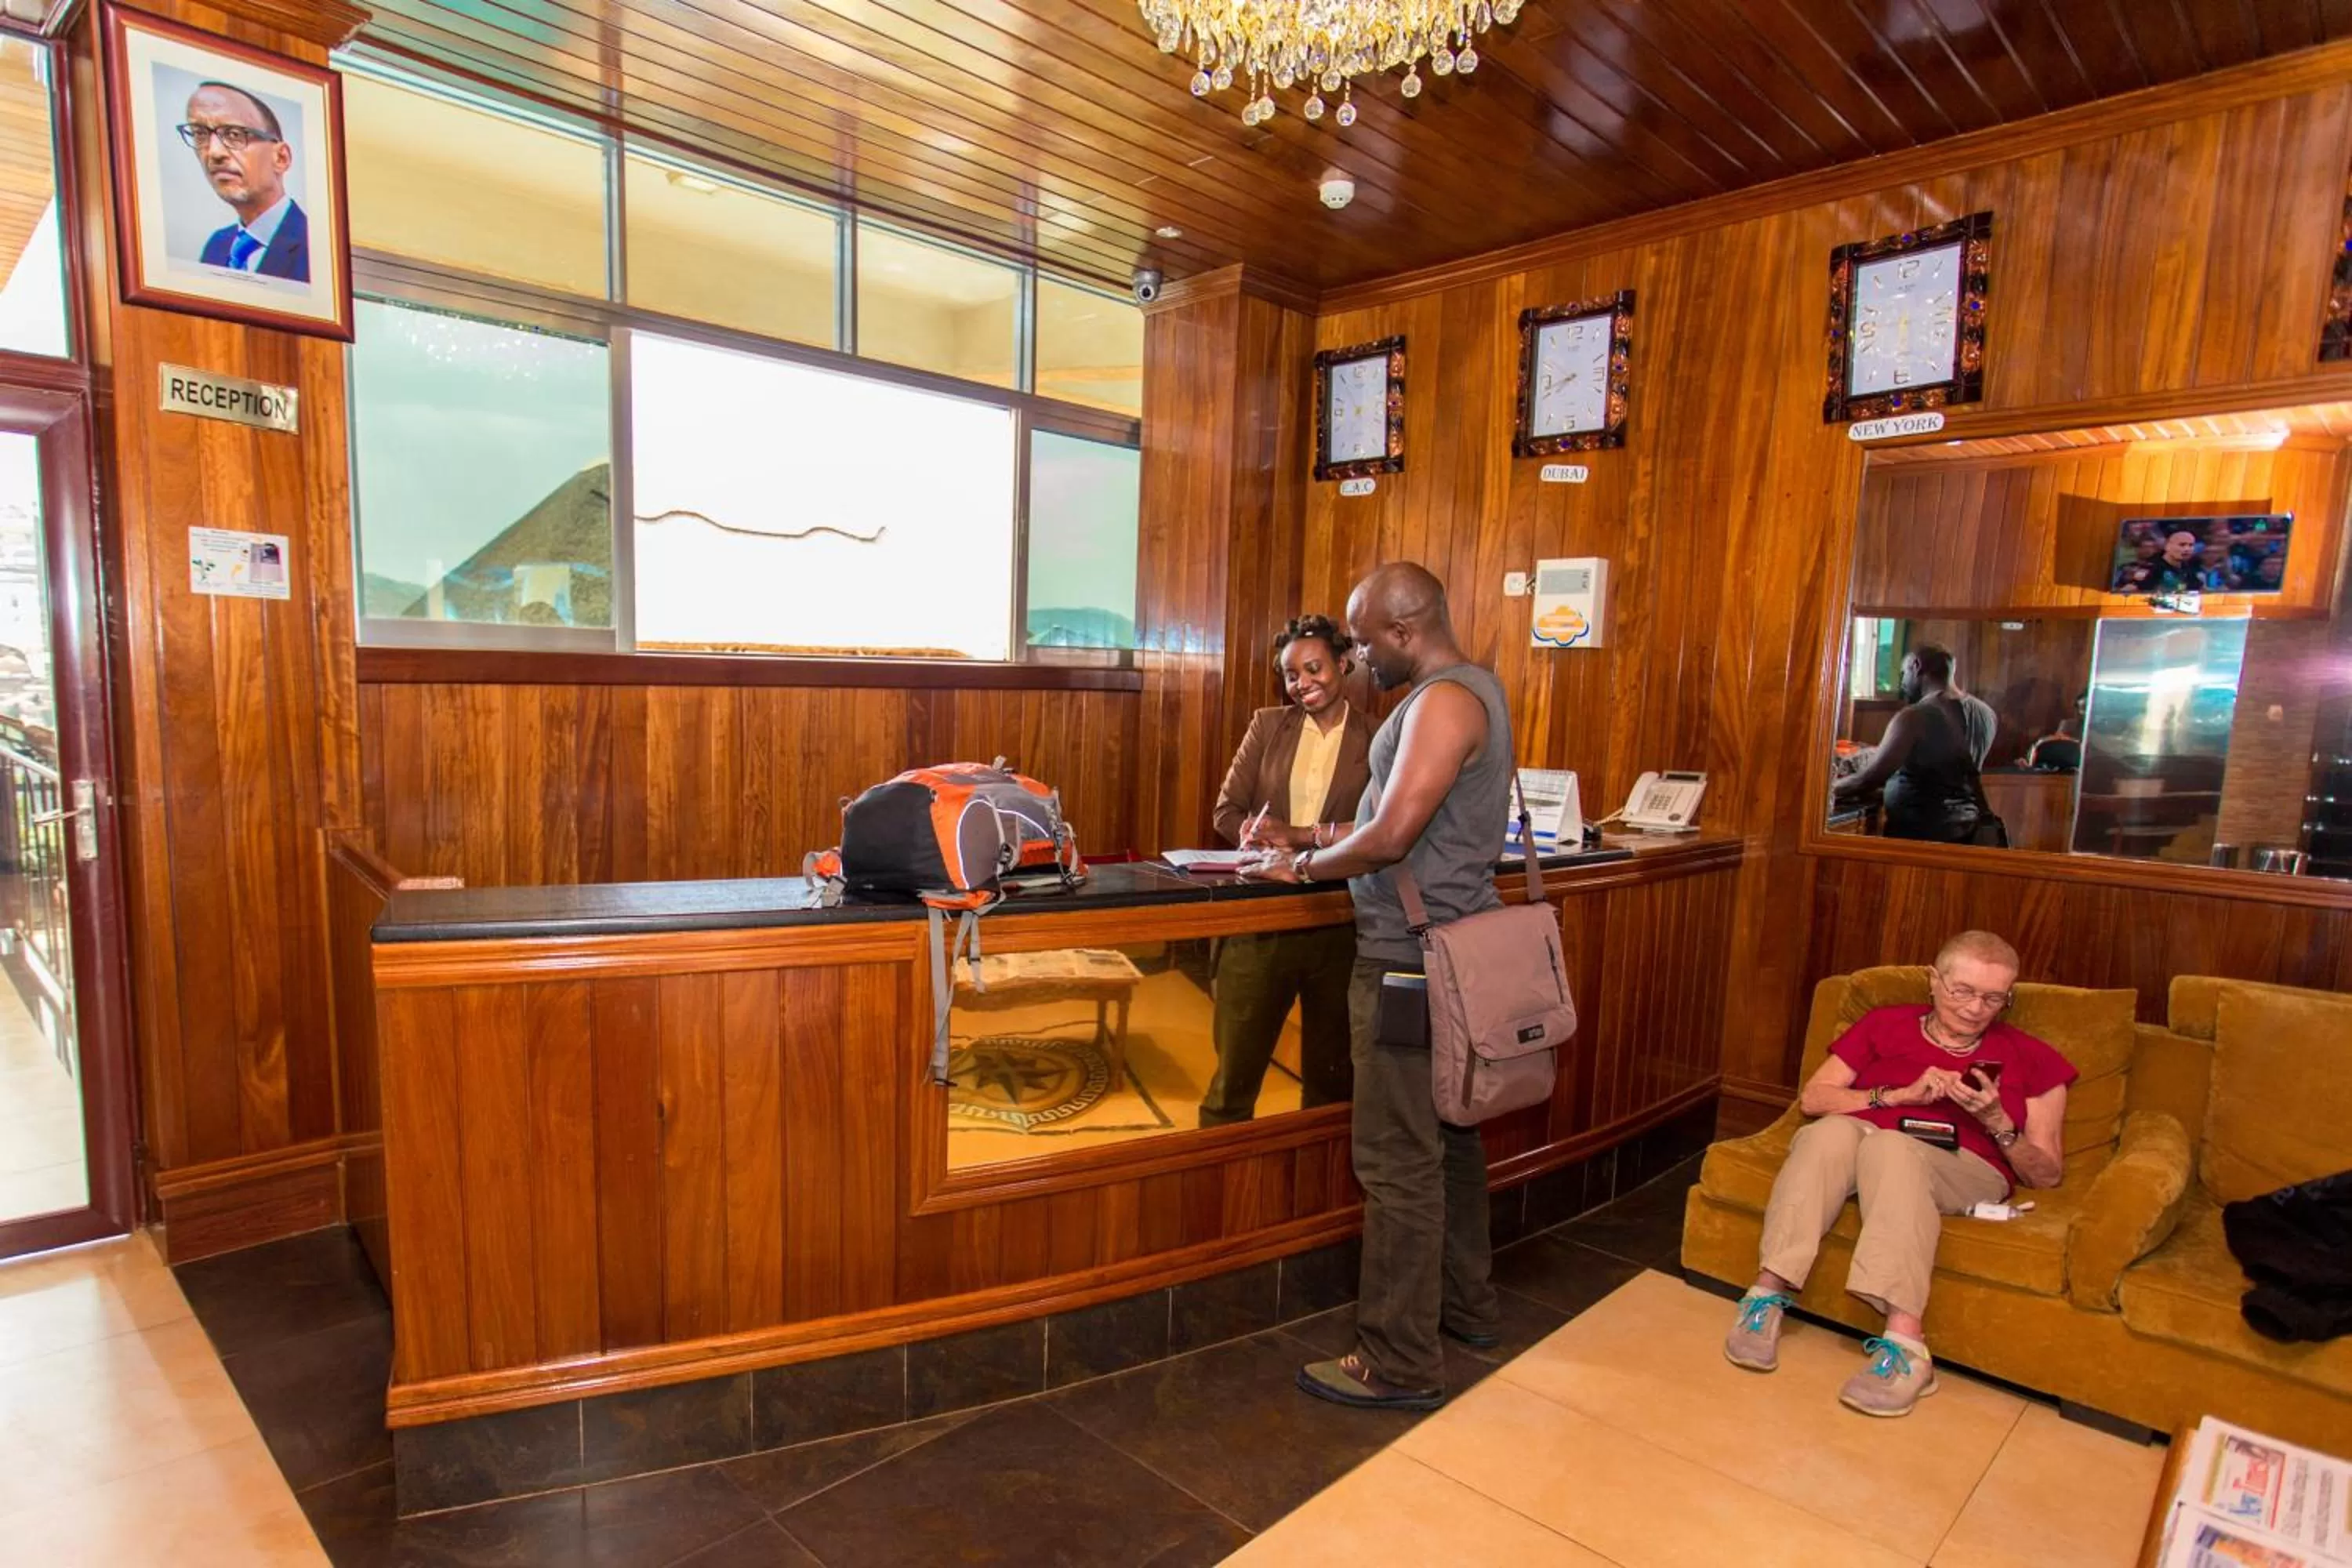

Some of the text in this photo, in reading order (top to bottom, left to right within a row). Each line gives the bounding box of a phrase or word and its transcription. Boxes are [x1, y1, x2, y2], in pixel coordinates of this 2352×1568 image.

[171, 378, 288, 419] RECEPTION
[1853, 416, 1940, 437] NEW YORK
[1543, 467, 1584, 480] DUBAI
